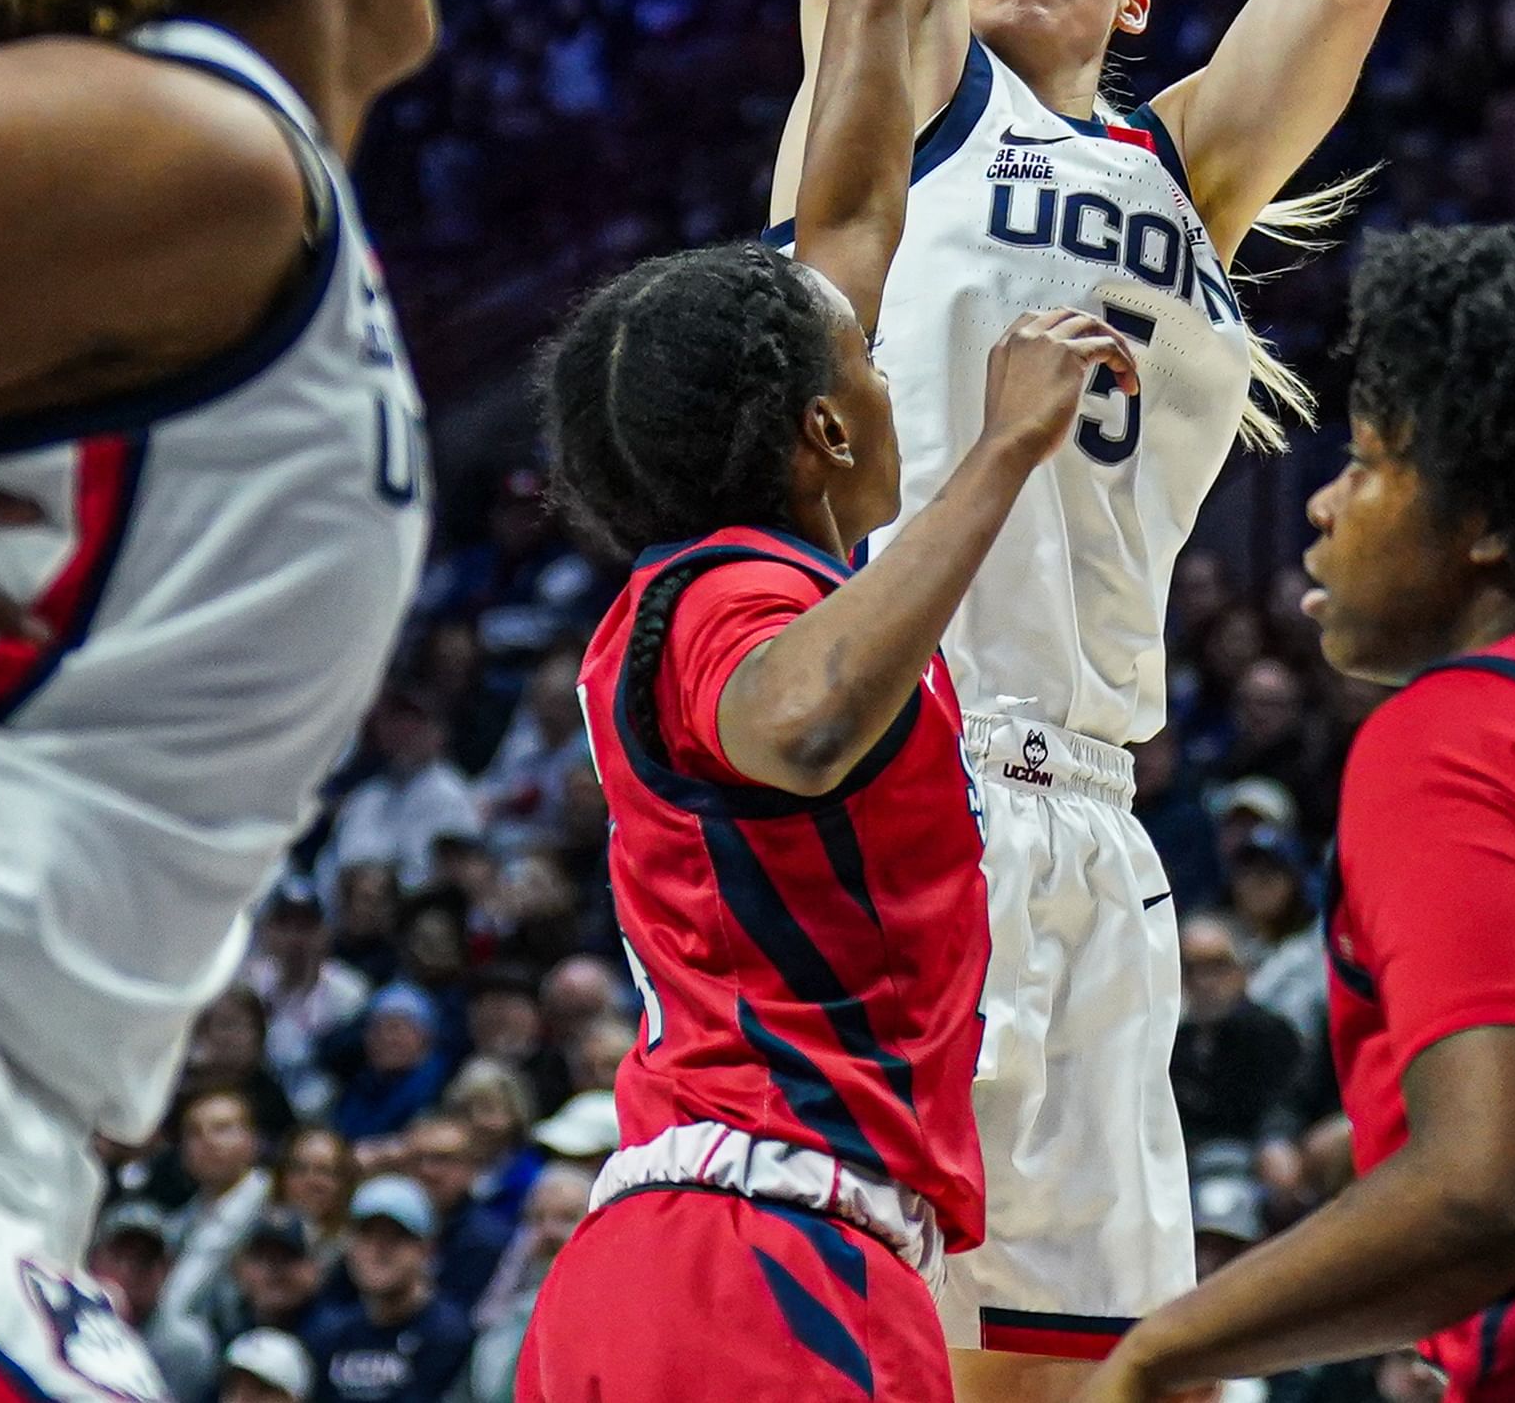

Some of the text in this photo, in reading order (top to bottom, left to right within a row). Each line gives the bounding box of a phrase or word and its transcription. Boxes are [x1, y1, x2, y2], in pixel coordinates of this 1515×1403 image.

[995, 148, 1052, 165] BE THE
[986, 163, 1055, 180] CHANGE
[1074, 300, 1160, 467] 5
[1002, 762, 1054, 788] UCONN
